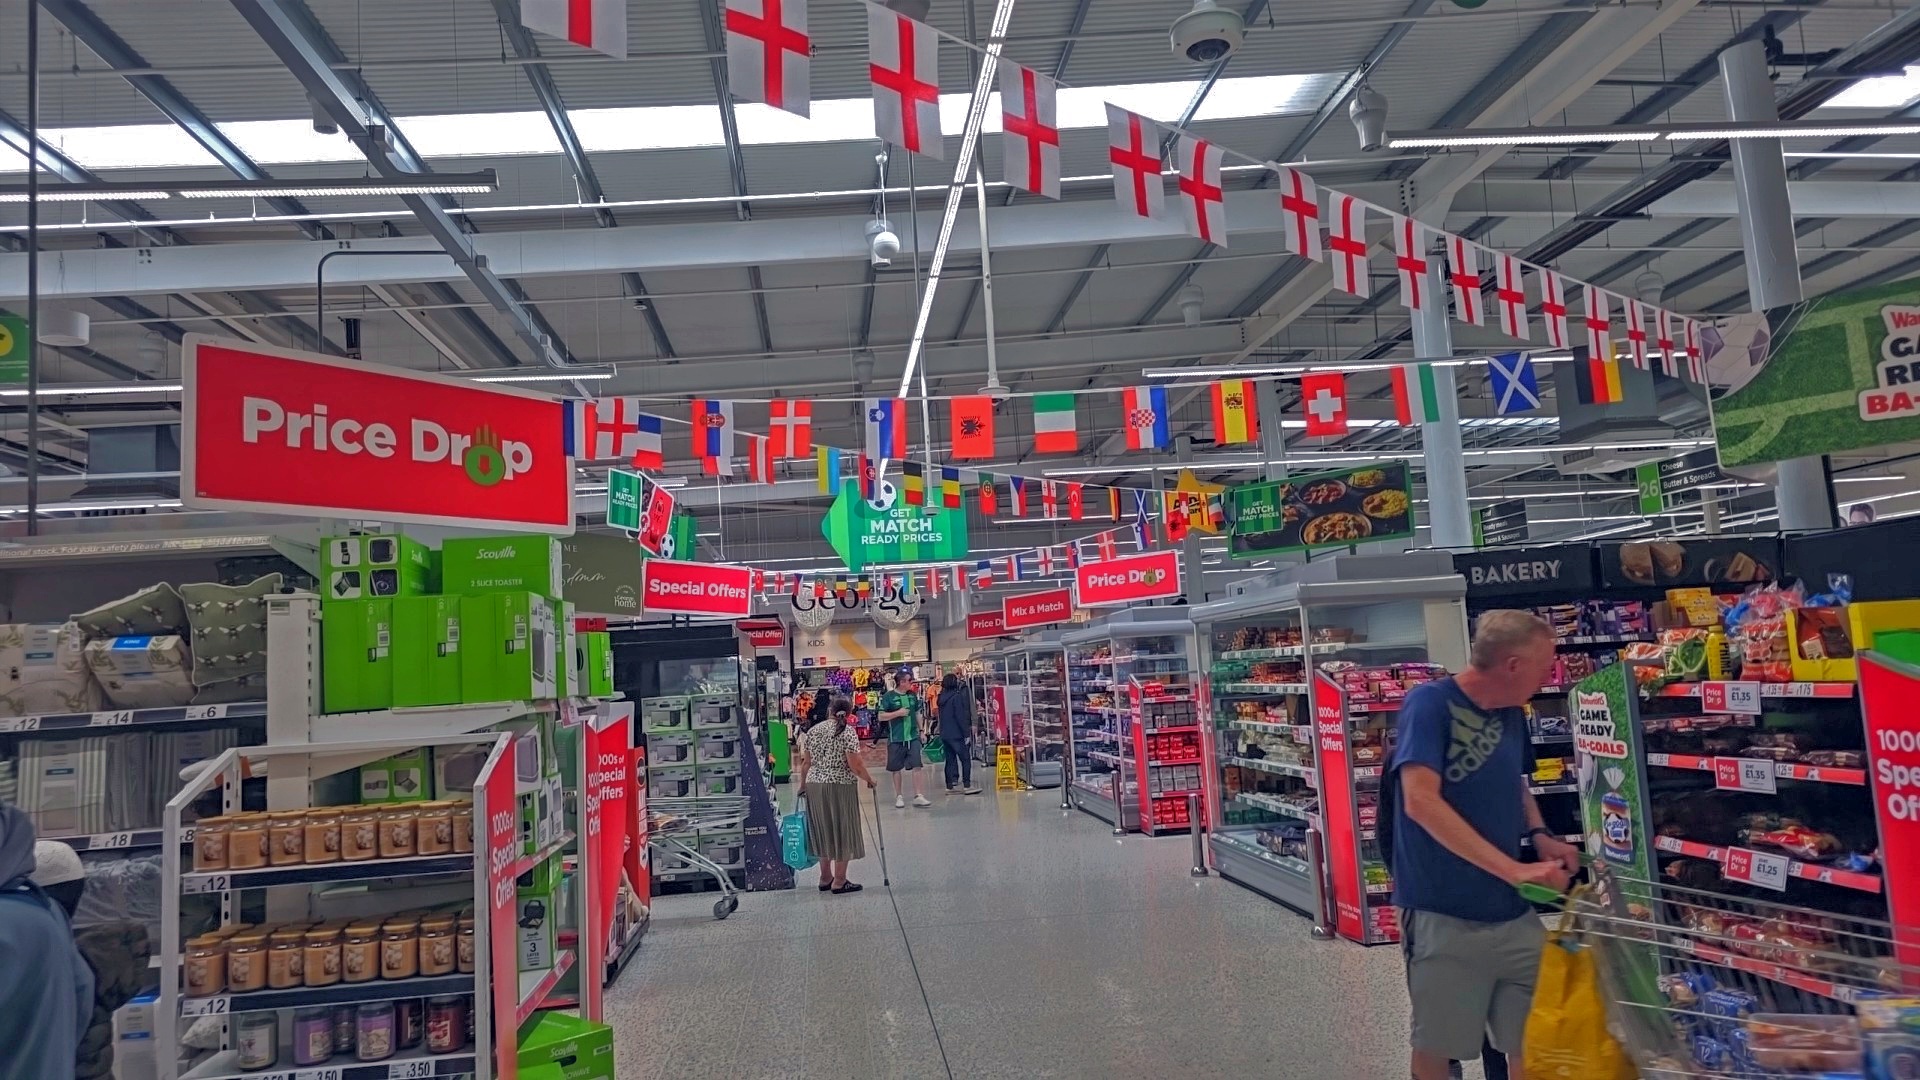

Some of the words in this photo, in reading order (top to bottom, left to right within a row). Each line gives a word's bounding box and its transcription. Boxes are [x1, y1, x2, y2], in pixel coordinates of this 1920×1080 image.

[243, 396, 397, 459] Price
[411, 418, 534, 486] Drop
[1661, 461, 1684, 472] Cheese
[1663, 479, 1682, 489] Butter
[1683, 476, 1689, 484] &
[1689, 470, 1716, 483] Spreads
[1640, 480, 1659, 499] 26
[615, 492, 636, 503] MATCH
[890, 508, 911, 517] GET
[1238, 513, 1257, 521] READY
[1258, 511, 1280, 519] PRICES
[1242, 505, 1274, 516] MATCH
[870, 518, 932, 534] MATCH
[861, 534, 900, 545] READY
[902, 532, 943, 543] PRICES
[101, 543, 128, 553] safety
[476, 546, 517, 560] Scoville
[1088, 574, 1125, 588] Price
[1128, 566, 1166, 587] Drop
[1471, 559, 1562, 585] BAKERY
[476, 579, 493, 587] SLICE
[495, 578, 523, 586] TOASTER
[649, 578, 705, 596] Special
[707, 582, 747, 599] Offers
[1011, 606, 1027, 617] Mix
[1028, 605, 1035, 614] &
[1037, 601, 1064, 613] Match
[973, 620, 994, 629] Price
[765, 628, 783, 639] Offers
[1718, 642, 1730, 675] PRIME
[1706, 688, 1721, 696] Price
[1707, 696, 1722, 704] Drp
[107, 712, 129, 724] £14
[201, 706, 216, 718] £6
[1318, 707, 1333, 719] 1000s
[1334, 709, 1340, 718] of
[1580, 709, 1608, 722] GAME
[14, 718, 37, 730] £12
[1318, 721, 1343, 735] Special
[1580, 723, 1612, 738] READY
[1321, 737, 1343, 752] Offers
[1445, 716, 1504, 782] adidas
[1578, 738, 1625, 755] BA-GOALS
[618, 755, 625, 764] of
[1719, 765, 1735, 773] Price
[599, 767, 626, 785] pecial
[1720, 773, 1736, 782] Drp
[492, 810, 509, 838] 1000s
[104, 834, 128, 847] £18
[492, 835, 515, 876] Special
[1731, 854, 1748, 865] Price
[1730, 862, 1747, 873] Drp
[1757, 864, 1778, 875] £1.25
[201, 877, 226, 892] £12
[496, 877, 514, 909] Offers
[530, 942, 537, 952] 3
[201, 999, 226, 1014] £12
[550, 1041, 578, 1058] Scoville
[406, 1062, 430, 1078] £3.50
